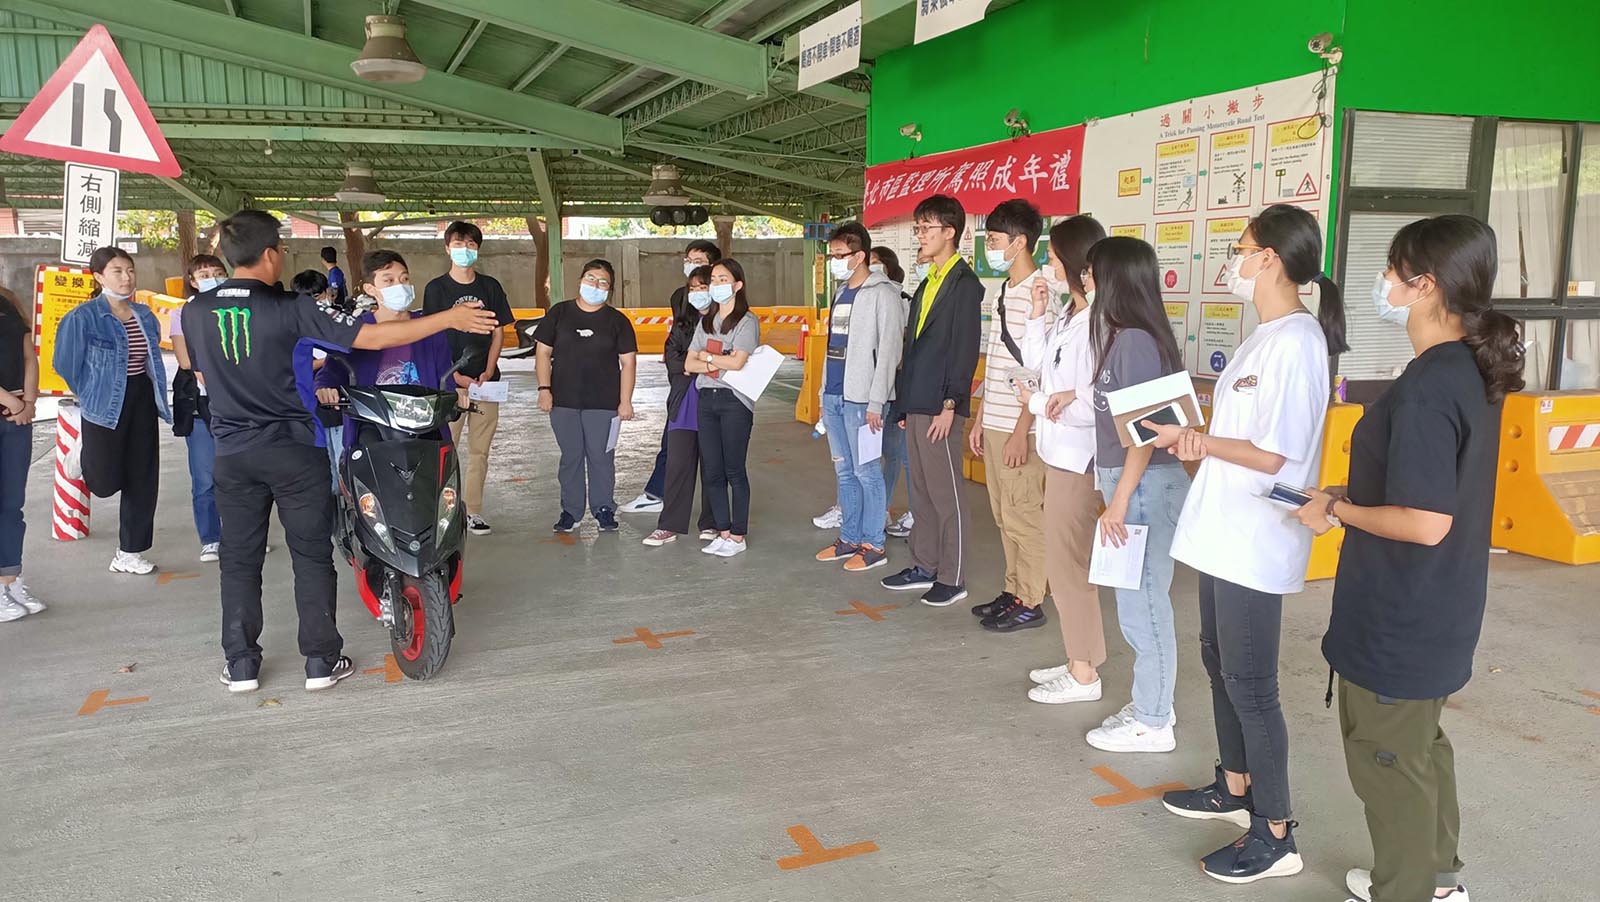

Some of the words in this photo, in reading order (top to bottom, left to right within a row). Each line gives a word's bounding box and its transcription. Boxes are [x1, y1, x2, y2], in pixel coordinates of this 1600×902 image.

[1206, 118, 1236, 130] Motorcycle
[1237, 115, 1252, 125] Road
[1253, 114, 1265, 122] Test
[77, 173, 103, 257] 右側縮減
